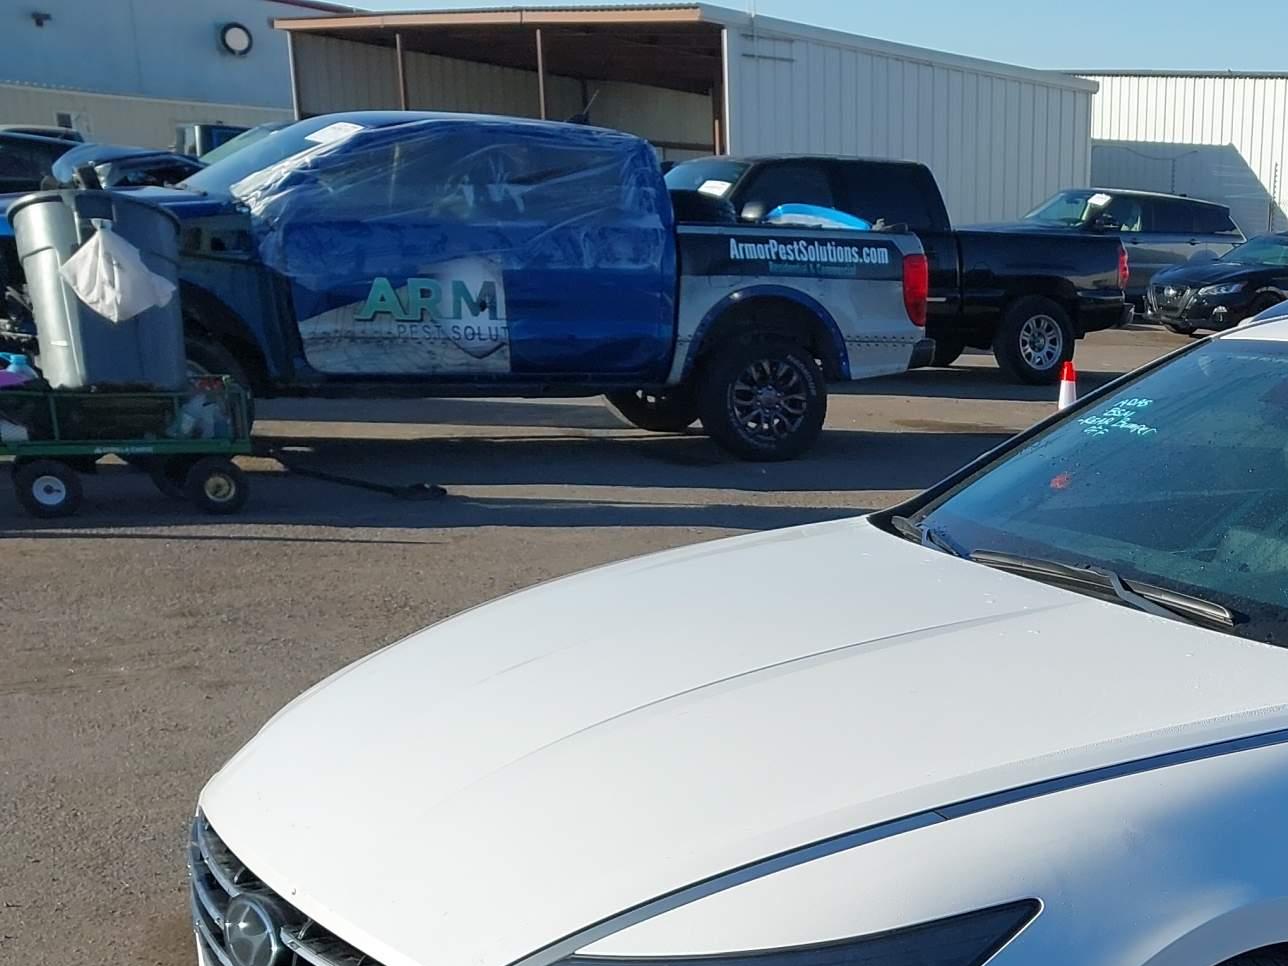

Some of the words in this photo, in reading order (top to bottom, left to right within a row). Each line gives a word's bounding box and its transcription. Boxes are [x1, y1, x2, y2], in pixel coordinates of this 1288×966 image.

[729, 237, 889, 265] ArmorPestSolutions.com
[354, 276, 498, 322] ARM
[397, 323, 445, 341] PEST
